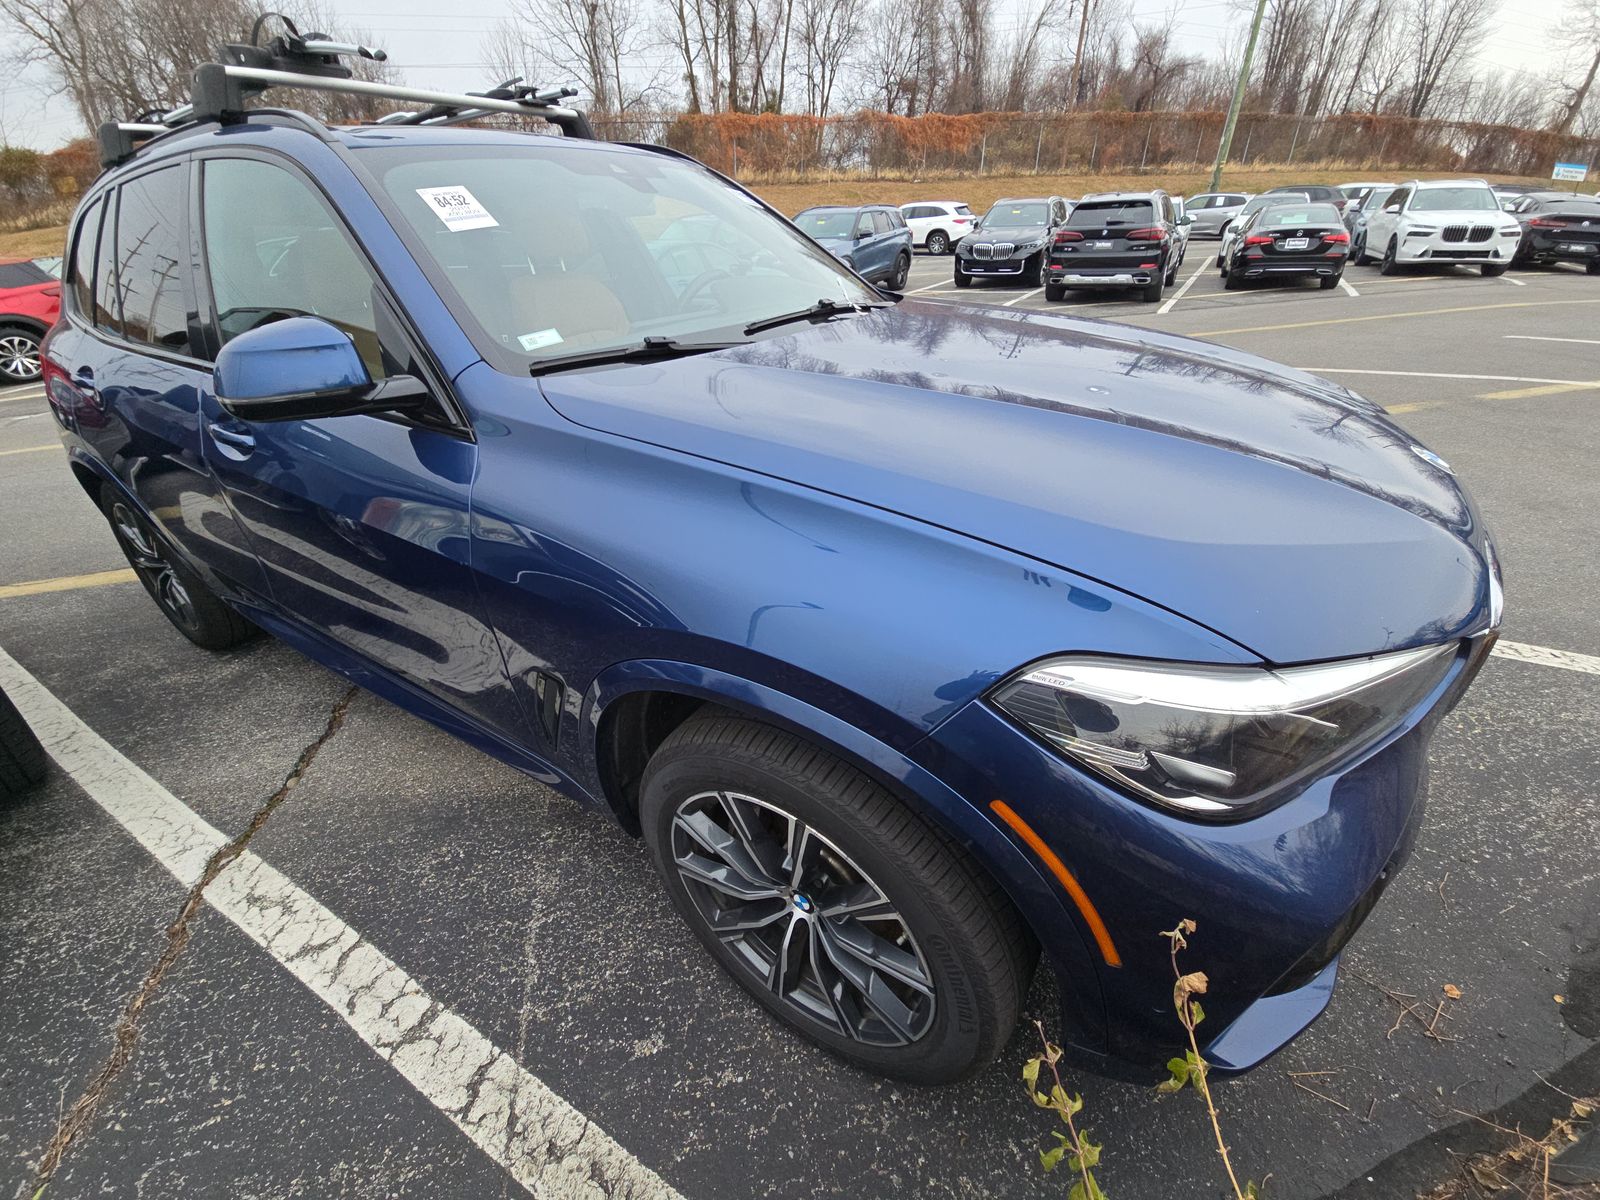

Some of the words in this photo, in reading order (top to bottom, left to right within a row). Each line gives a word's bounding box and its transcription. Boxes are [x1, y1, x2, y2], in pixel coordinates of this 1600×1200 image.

[433, 194, 470, 208] 84:52
[1048, 678, 1066, 686] LED
[927, 934, 975, 1025] Continental
